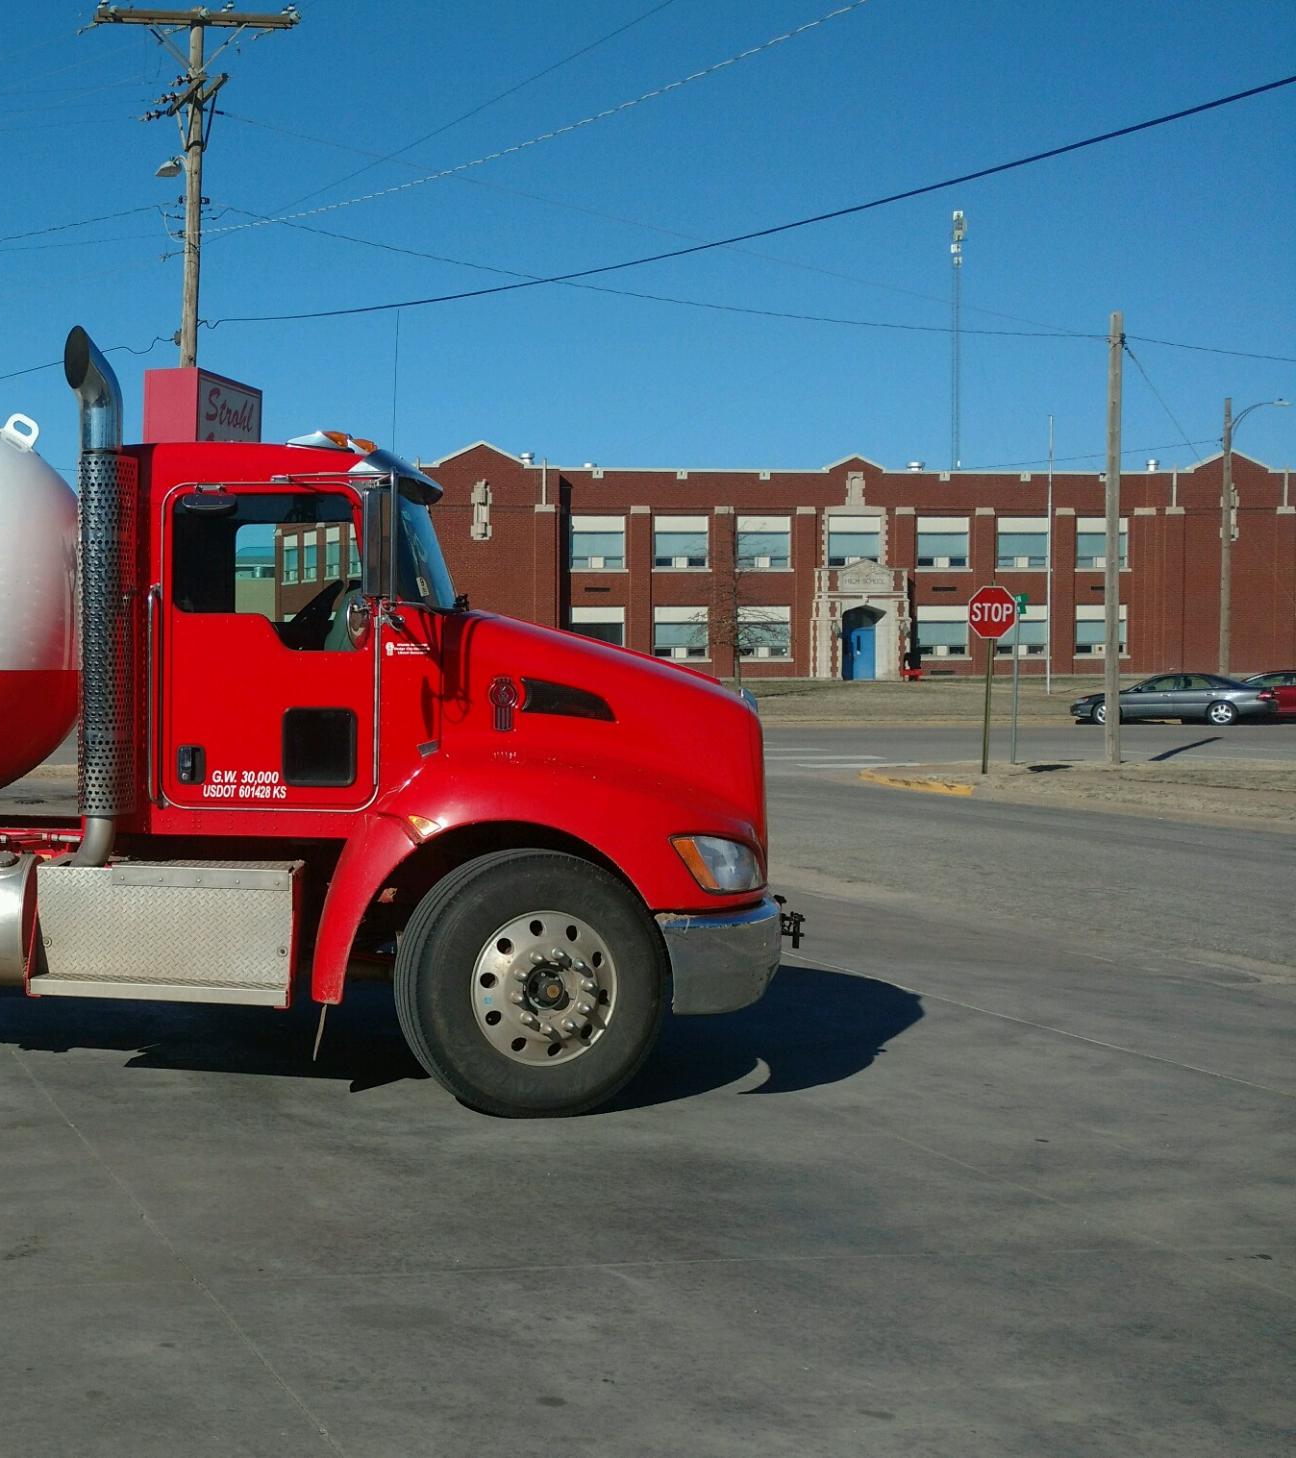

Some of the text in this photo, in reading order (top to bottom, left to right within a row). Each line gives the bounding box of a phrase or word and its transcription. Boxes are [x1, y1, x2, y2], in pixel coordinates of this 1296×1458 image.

[206, 387, 255, 433] Strohl
[971, 602, 1013, 622] STOP
[212, 770, 279, 785] G.W. 30,000
[203, 784, 287, 799] USDOT 601428 KS
